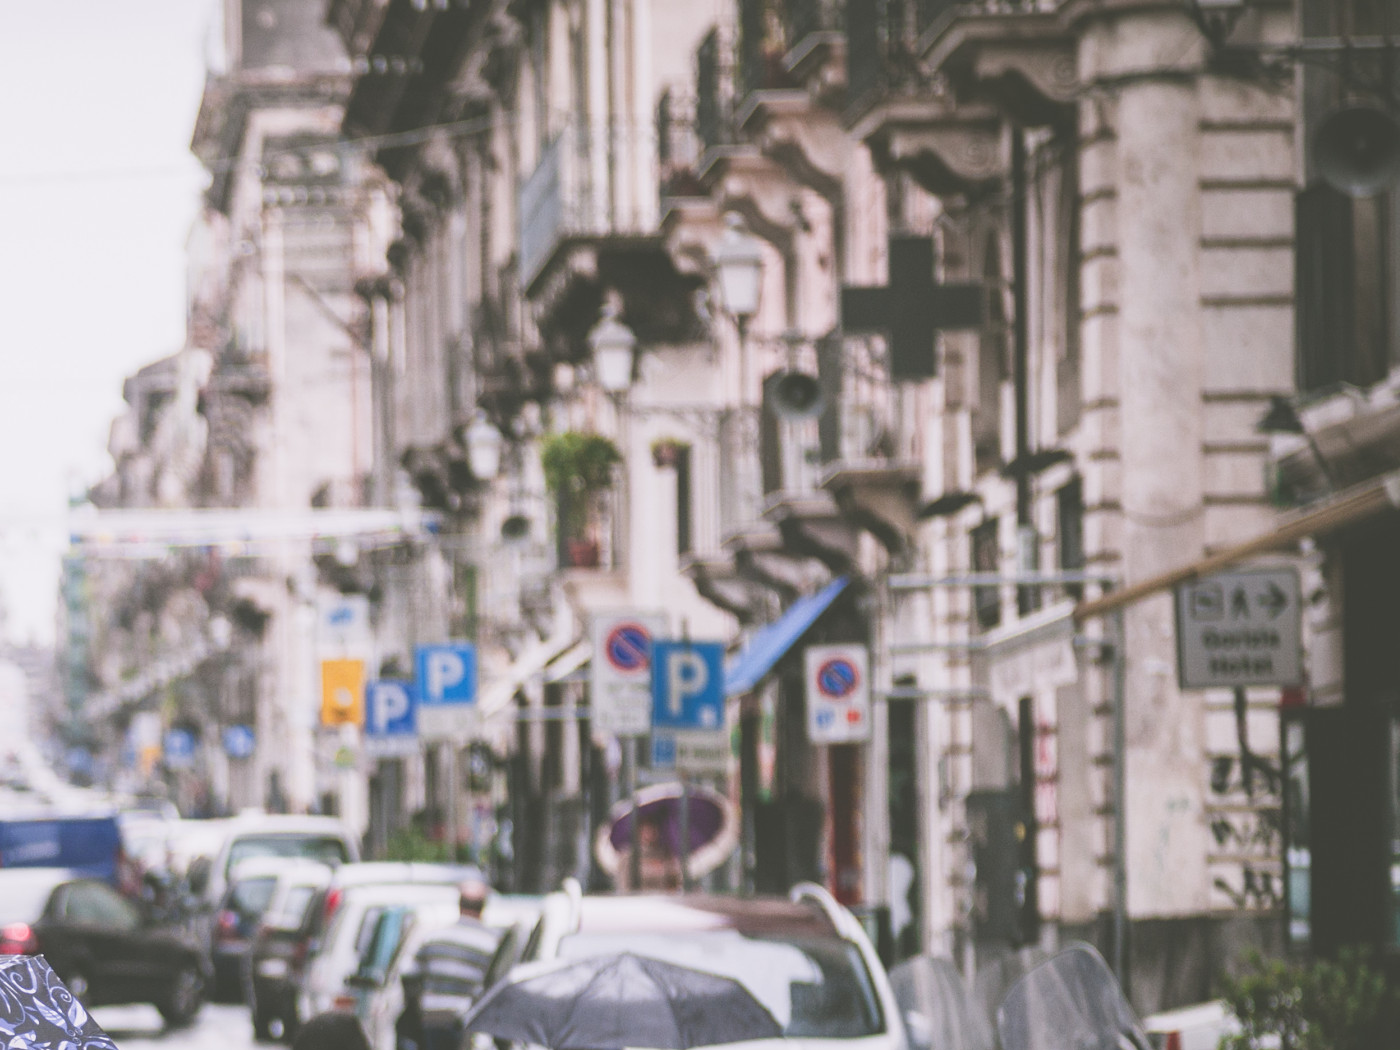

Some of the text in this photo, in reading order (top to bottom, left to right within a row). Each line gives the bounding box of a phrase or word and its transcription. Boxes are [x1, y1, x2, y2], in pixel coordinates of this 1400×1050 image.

[427, 651, 464, 698] P
[667, 653, 708, 716] P
[373, 683, 408, 731] P
